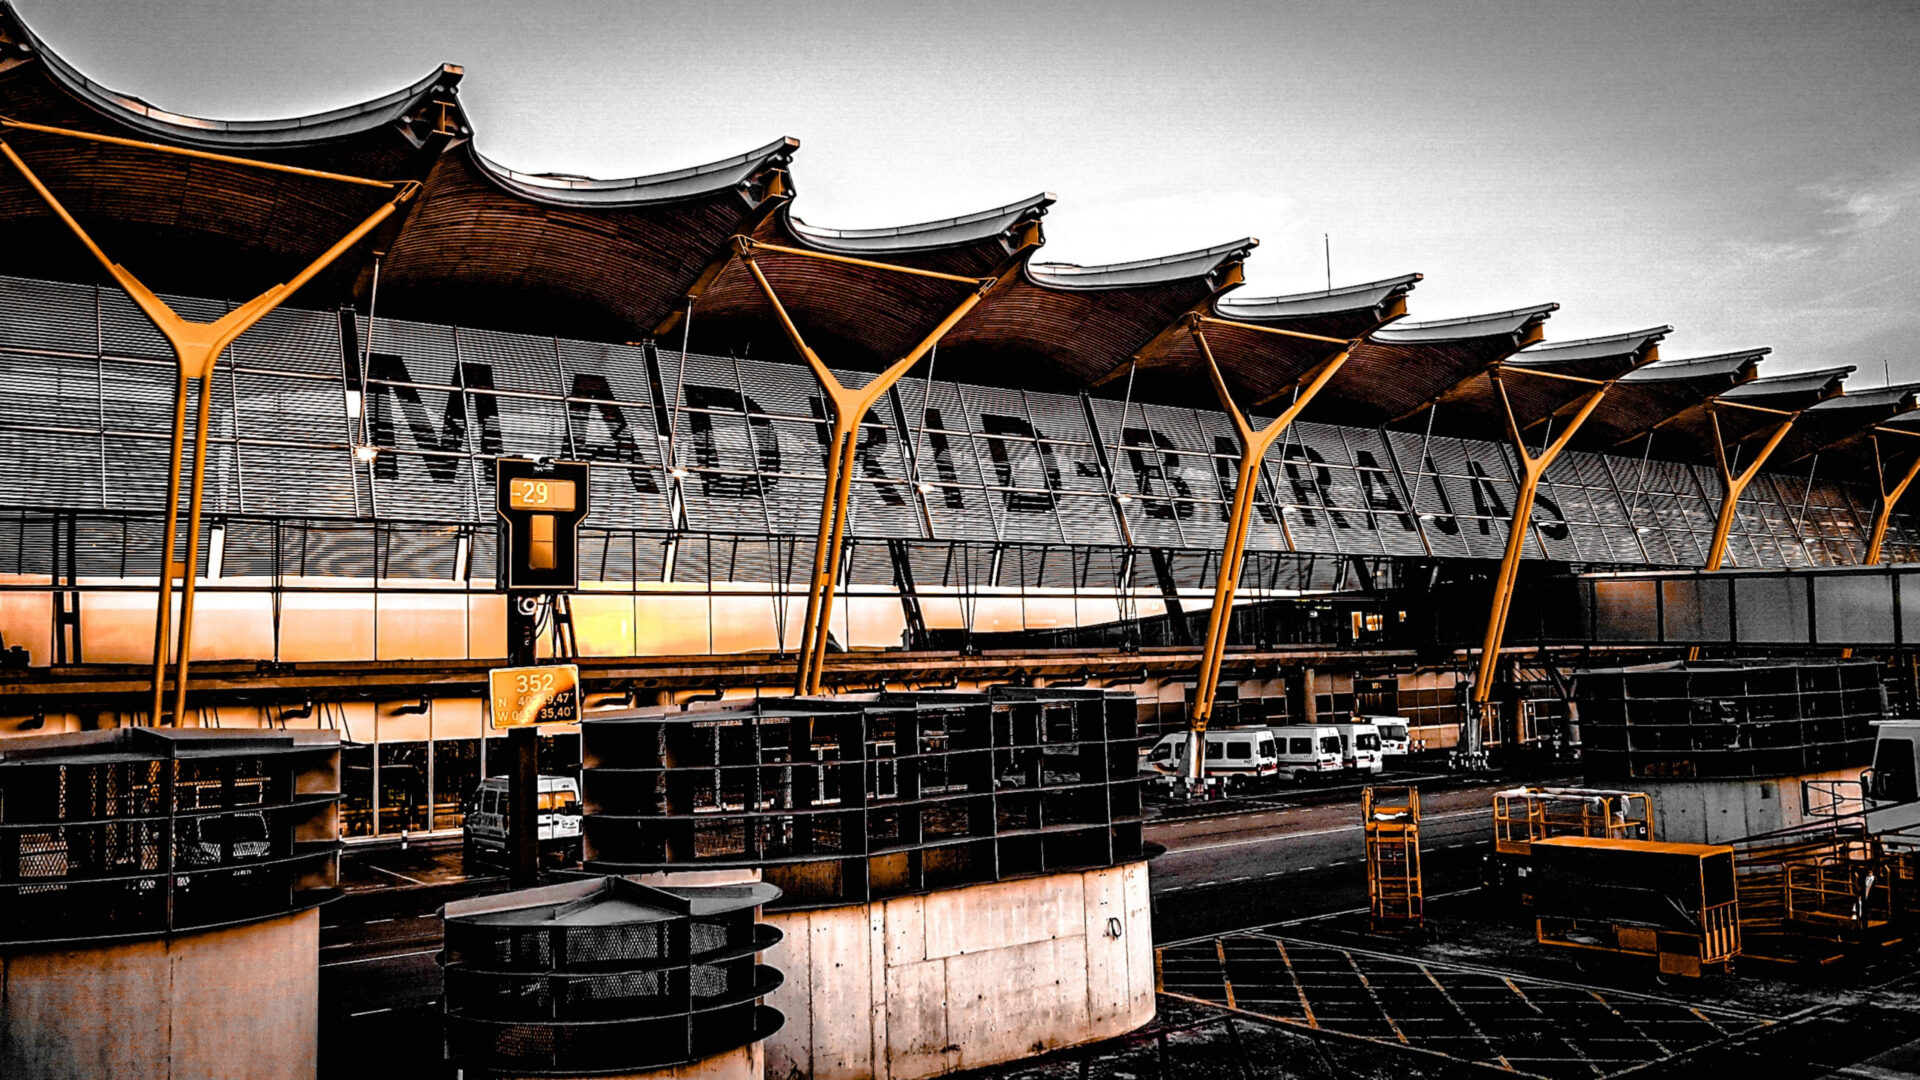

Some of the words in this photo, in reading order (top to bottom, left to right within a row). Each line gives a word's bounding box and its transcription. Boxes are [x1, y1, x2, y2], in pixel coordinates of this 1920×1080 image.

[516, 673, 554, 693] 352
[498, 697, 507, 708] N
[497, 711, 509, 722] W
